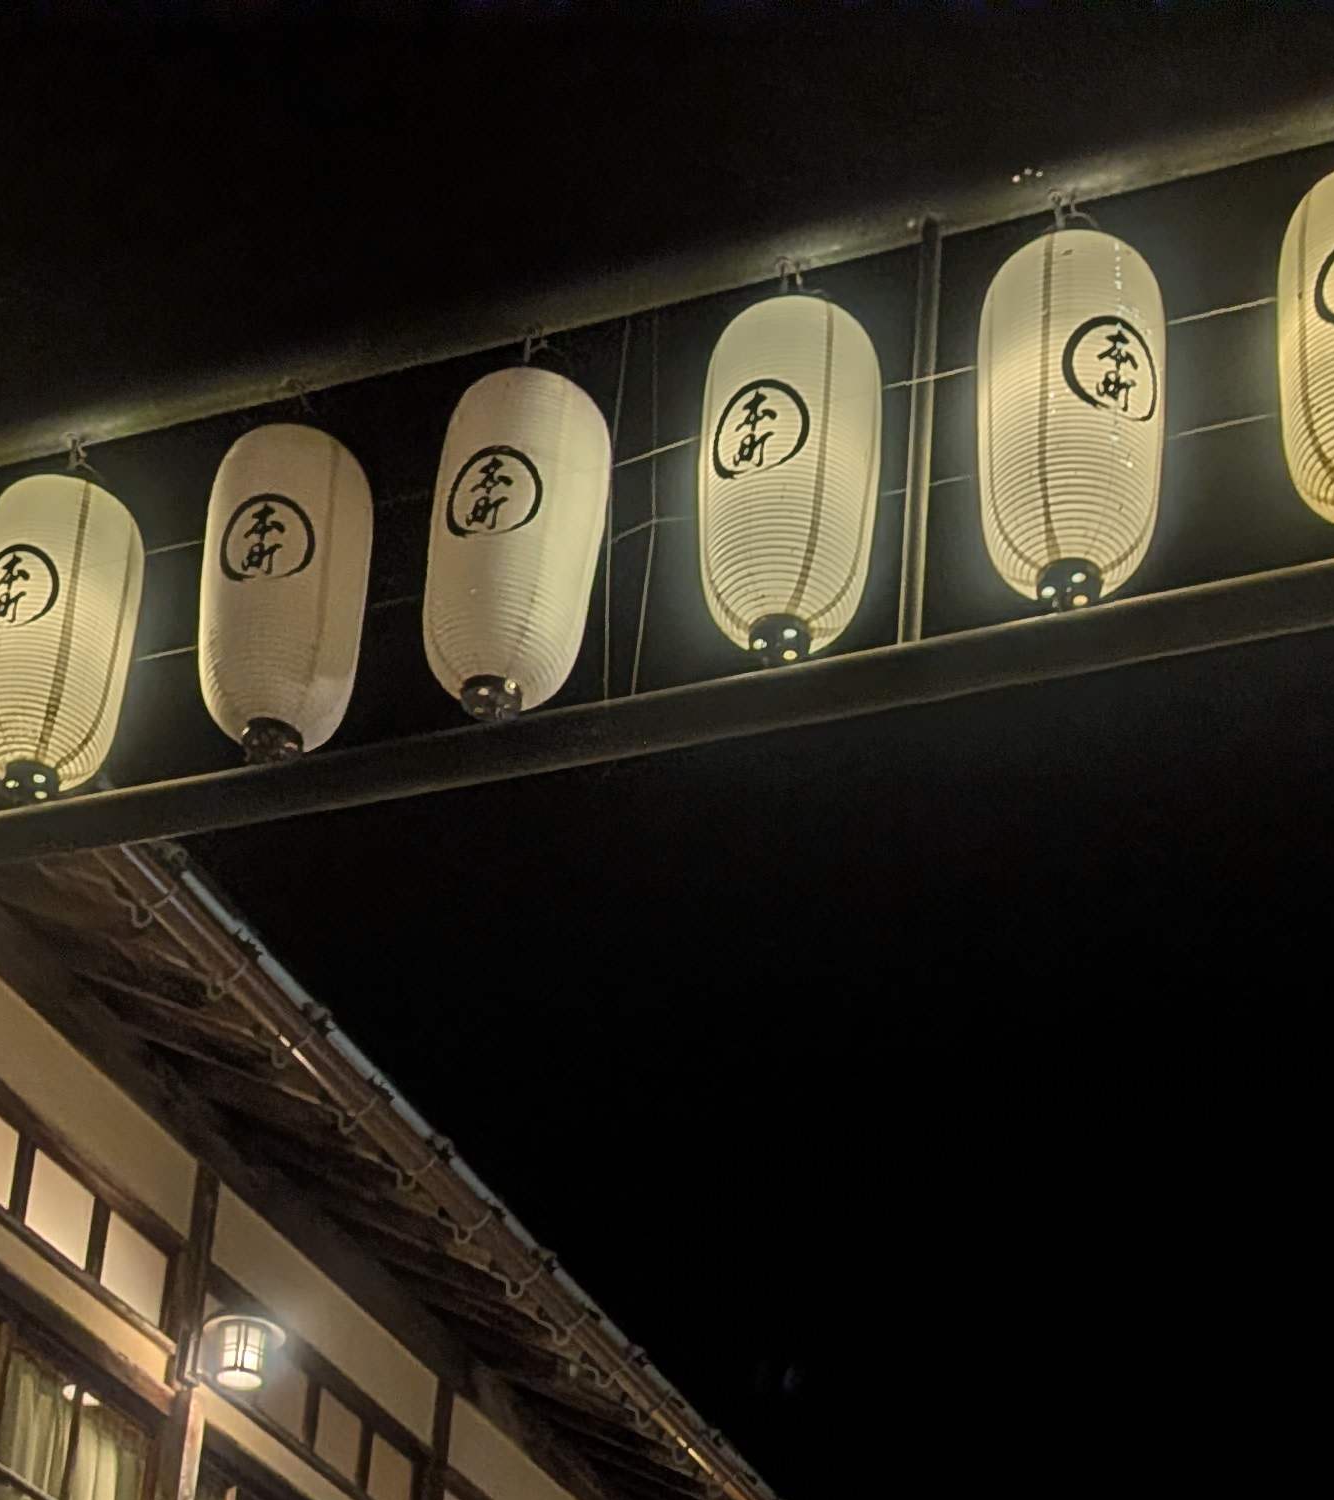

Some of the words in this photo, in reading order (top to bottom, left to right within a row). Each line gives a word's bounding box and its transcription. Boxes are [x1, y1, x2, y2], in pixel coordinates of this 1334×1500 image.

[1095, 327, 1140, 411] 本町
[734, 392, 777, 468] 本町
[470, 455, 514, 529] 本町
[241, 508, 284, 576] 本町
